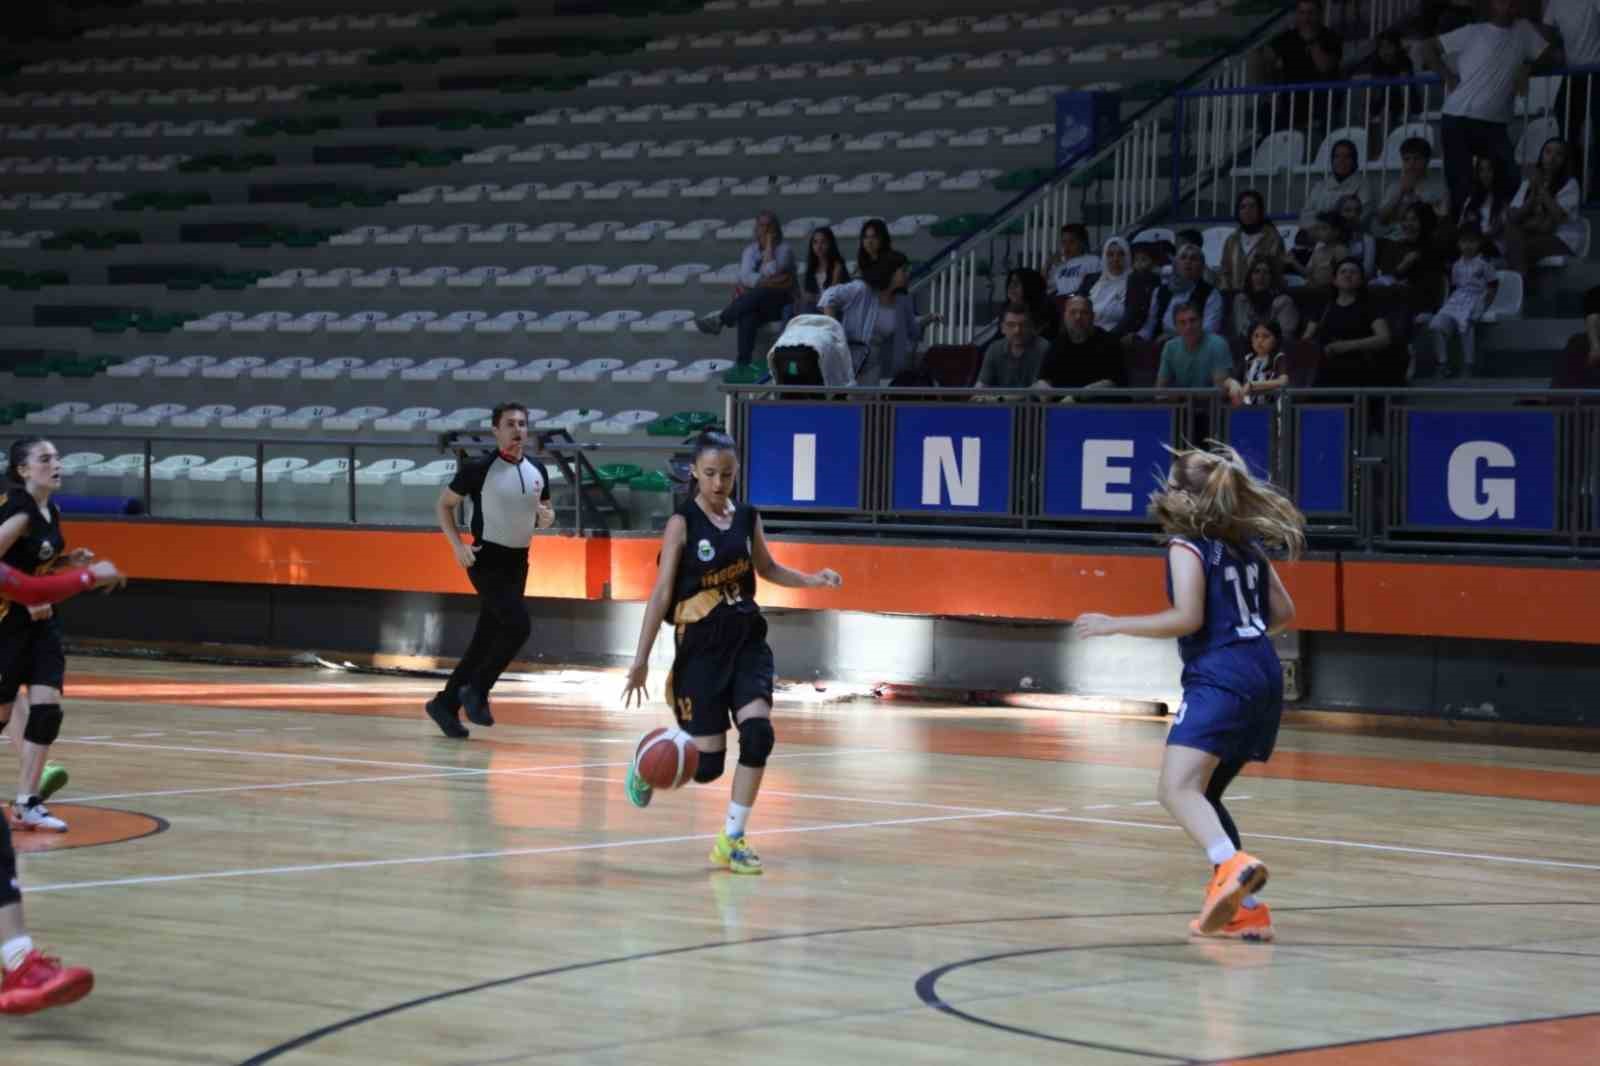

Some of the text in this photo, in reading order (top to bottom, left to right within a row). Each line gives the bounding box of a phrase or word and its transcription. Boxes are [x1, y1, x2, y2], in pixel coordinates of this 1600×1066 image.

[922, 436, 981, 506] N
[1081, 439, 1135, 511] E
[1447, 440, 1517, 521] G
